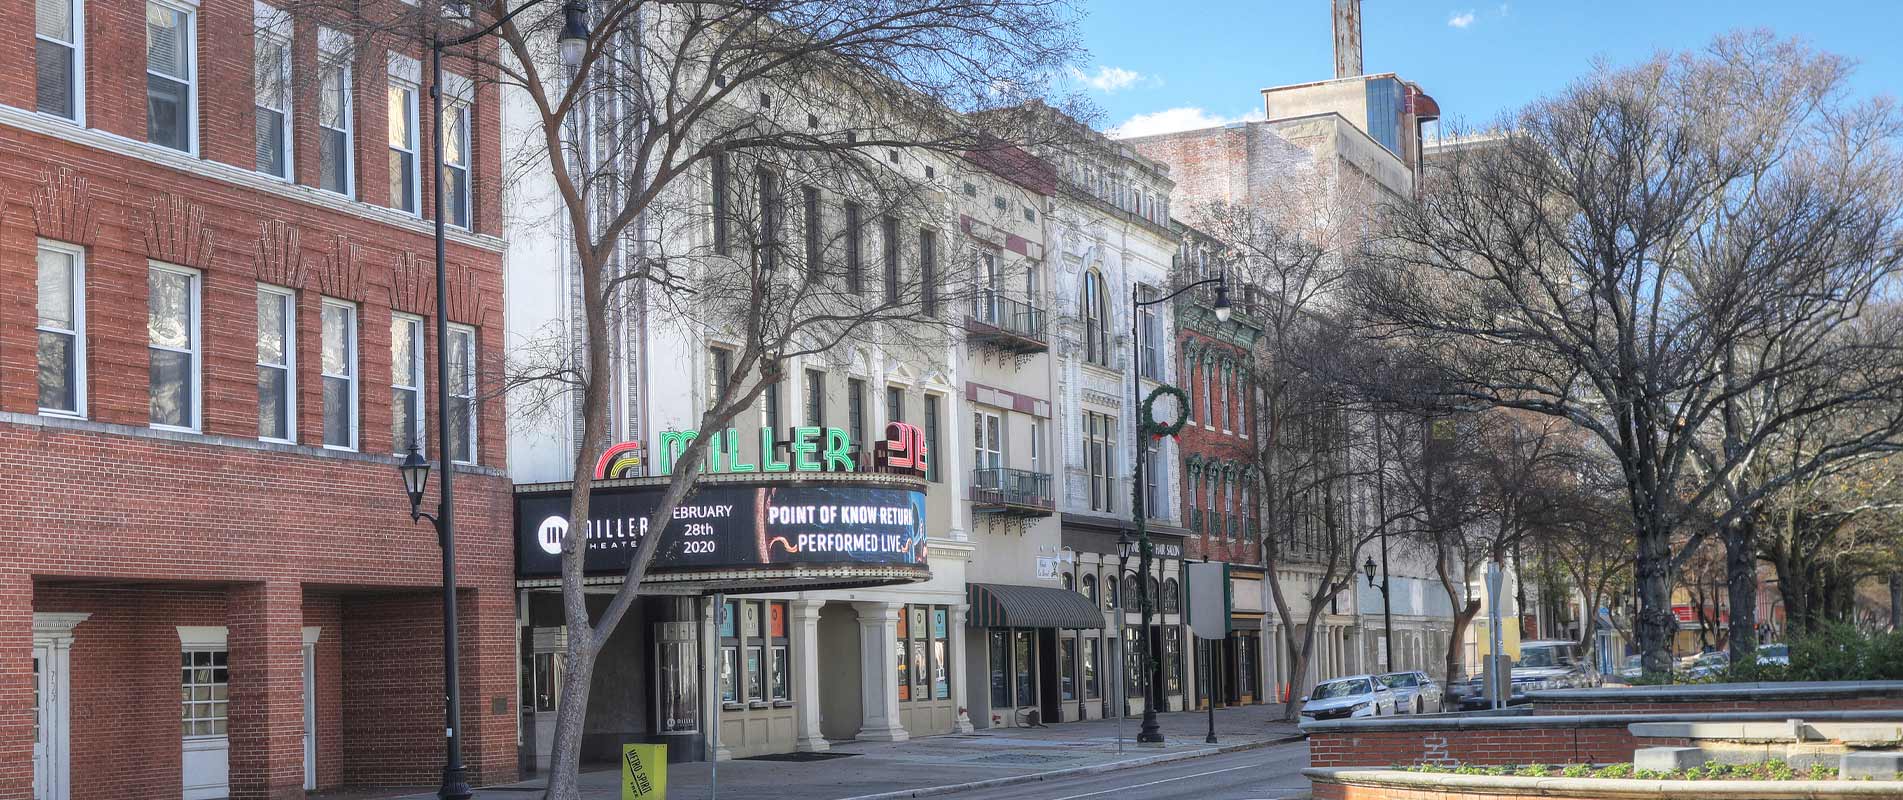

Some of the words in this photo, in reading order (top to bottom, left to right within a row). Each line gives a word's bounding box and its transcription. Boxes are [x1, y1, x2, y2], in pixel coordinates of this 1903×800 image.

[658, 425, 855, 475] MILLER
[672, 505, 733, 519] EBRUARY
[769, 505, 815, 525] POINT
[820, 505, 837, 524] OF
[841, 506, 877, 524] KNOW
[880, 507, 913, 526] RETURN
[684, 522, 714, 536] 28th
[589, 540, 638, 550] HEATE
[683, 540, 715, 553] 2020
[798, 533, 878, 552] PERFORMED
[881, 535, 901, 552] LIVE
[626, 748, 643, 772] METRO
